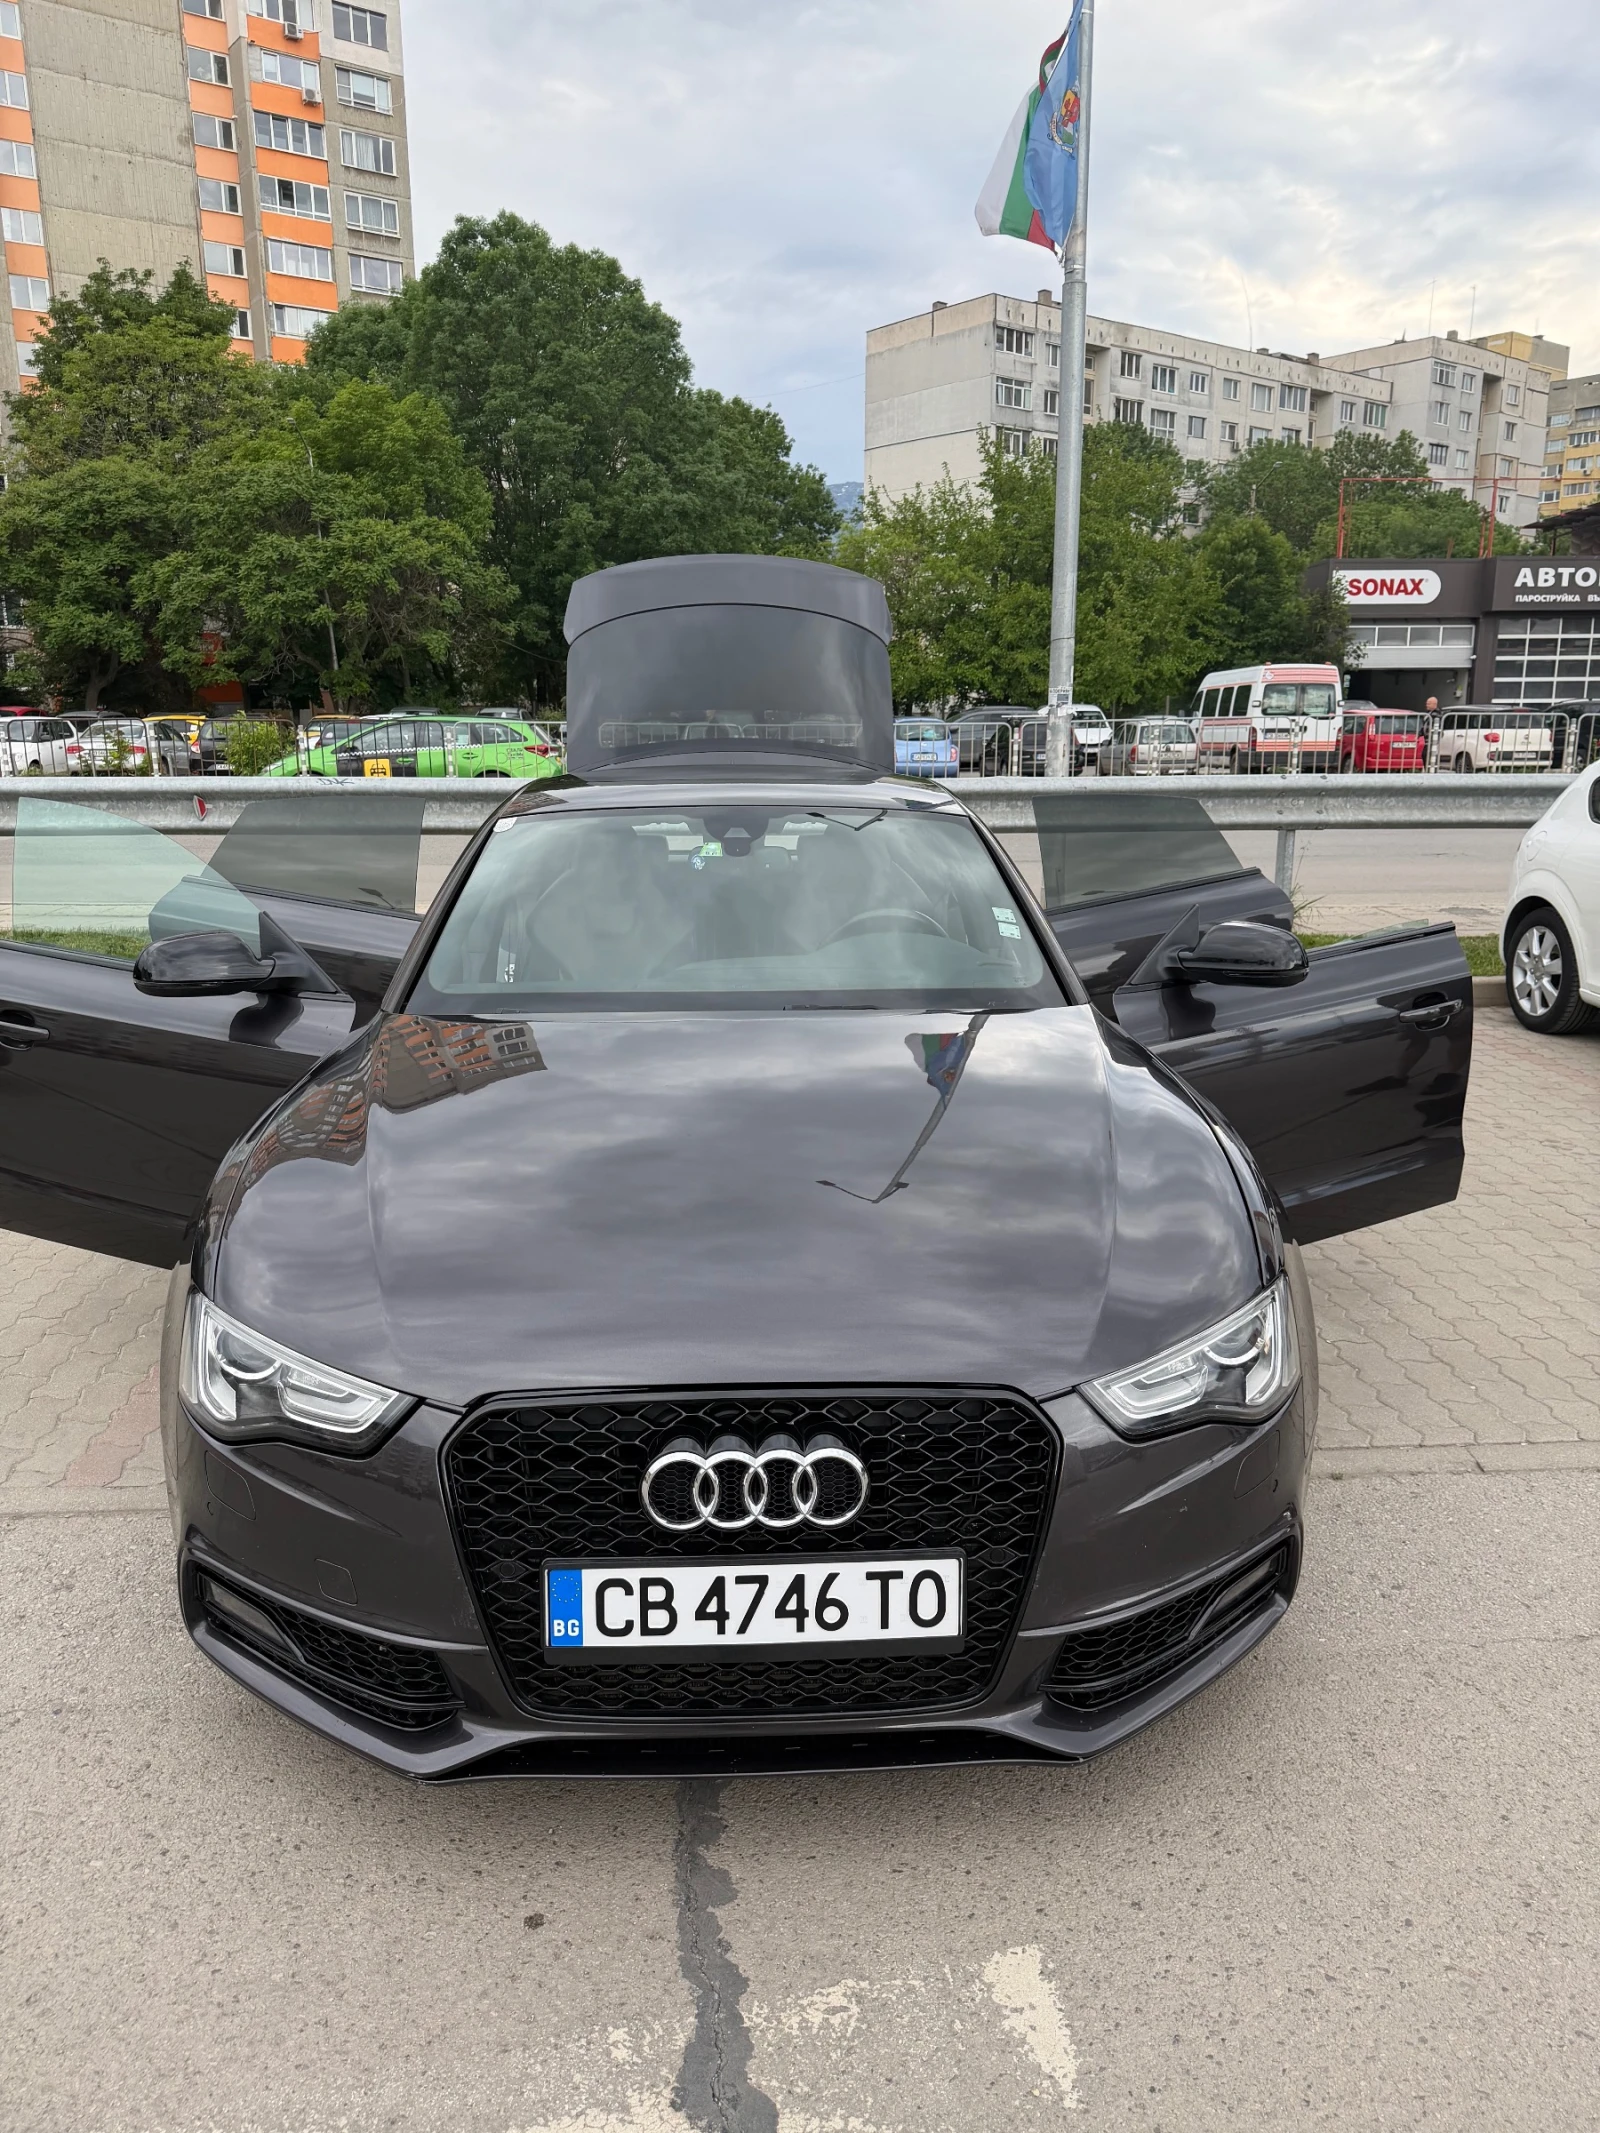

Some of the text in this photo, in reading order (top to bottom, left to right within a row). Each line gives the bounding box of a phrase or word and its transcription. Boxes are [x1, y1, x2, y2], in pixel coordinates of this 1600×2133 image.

[1514, 567, 1600, 587] АВТО
[1348, 578, 1424, 596] SONAX
[1515, 593, 1581, 602] ПАРОСТРУЙКА
[595, 1569, 947, 1638] CB 4746 TO
[553, 1620, 580, 1637] BG
